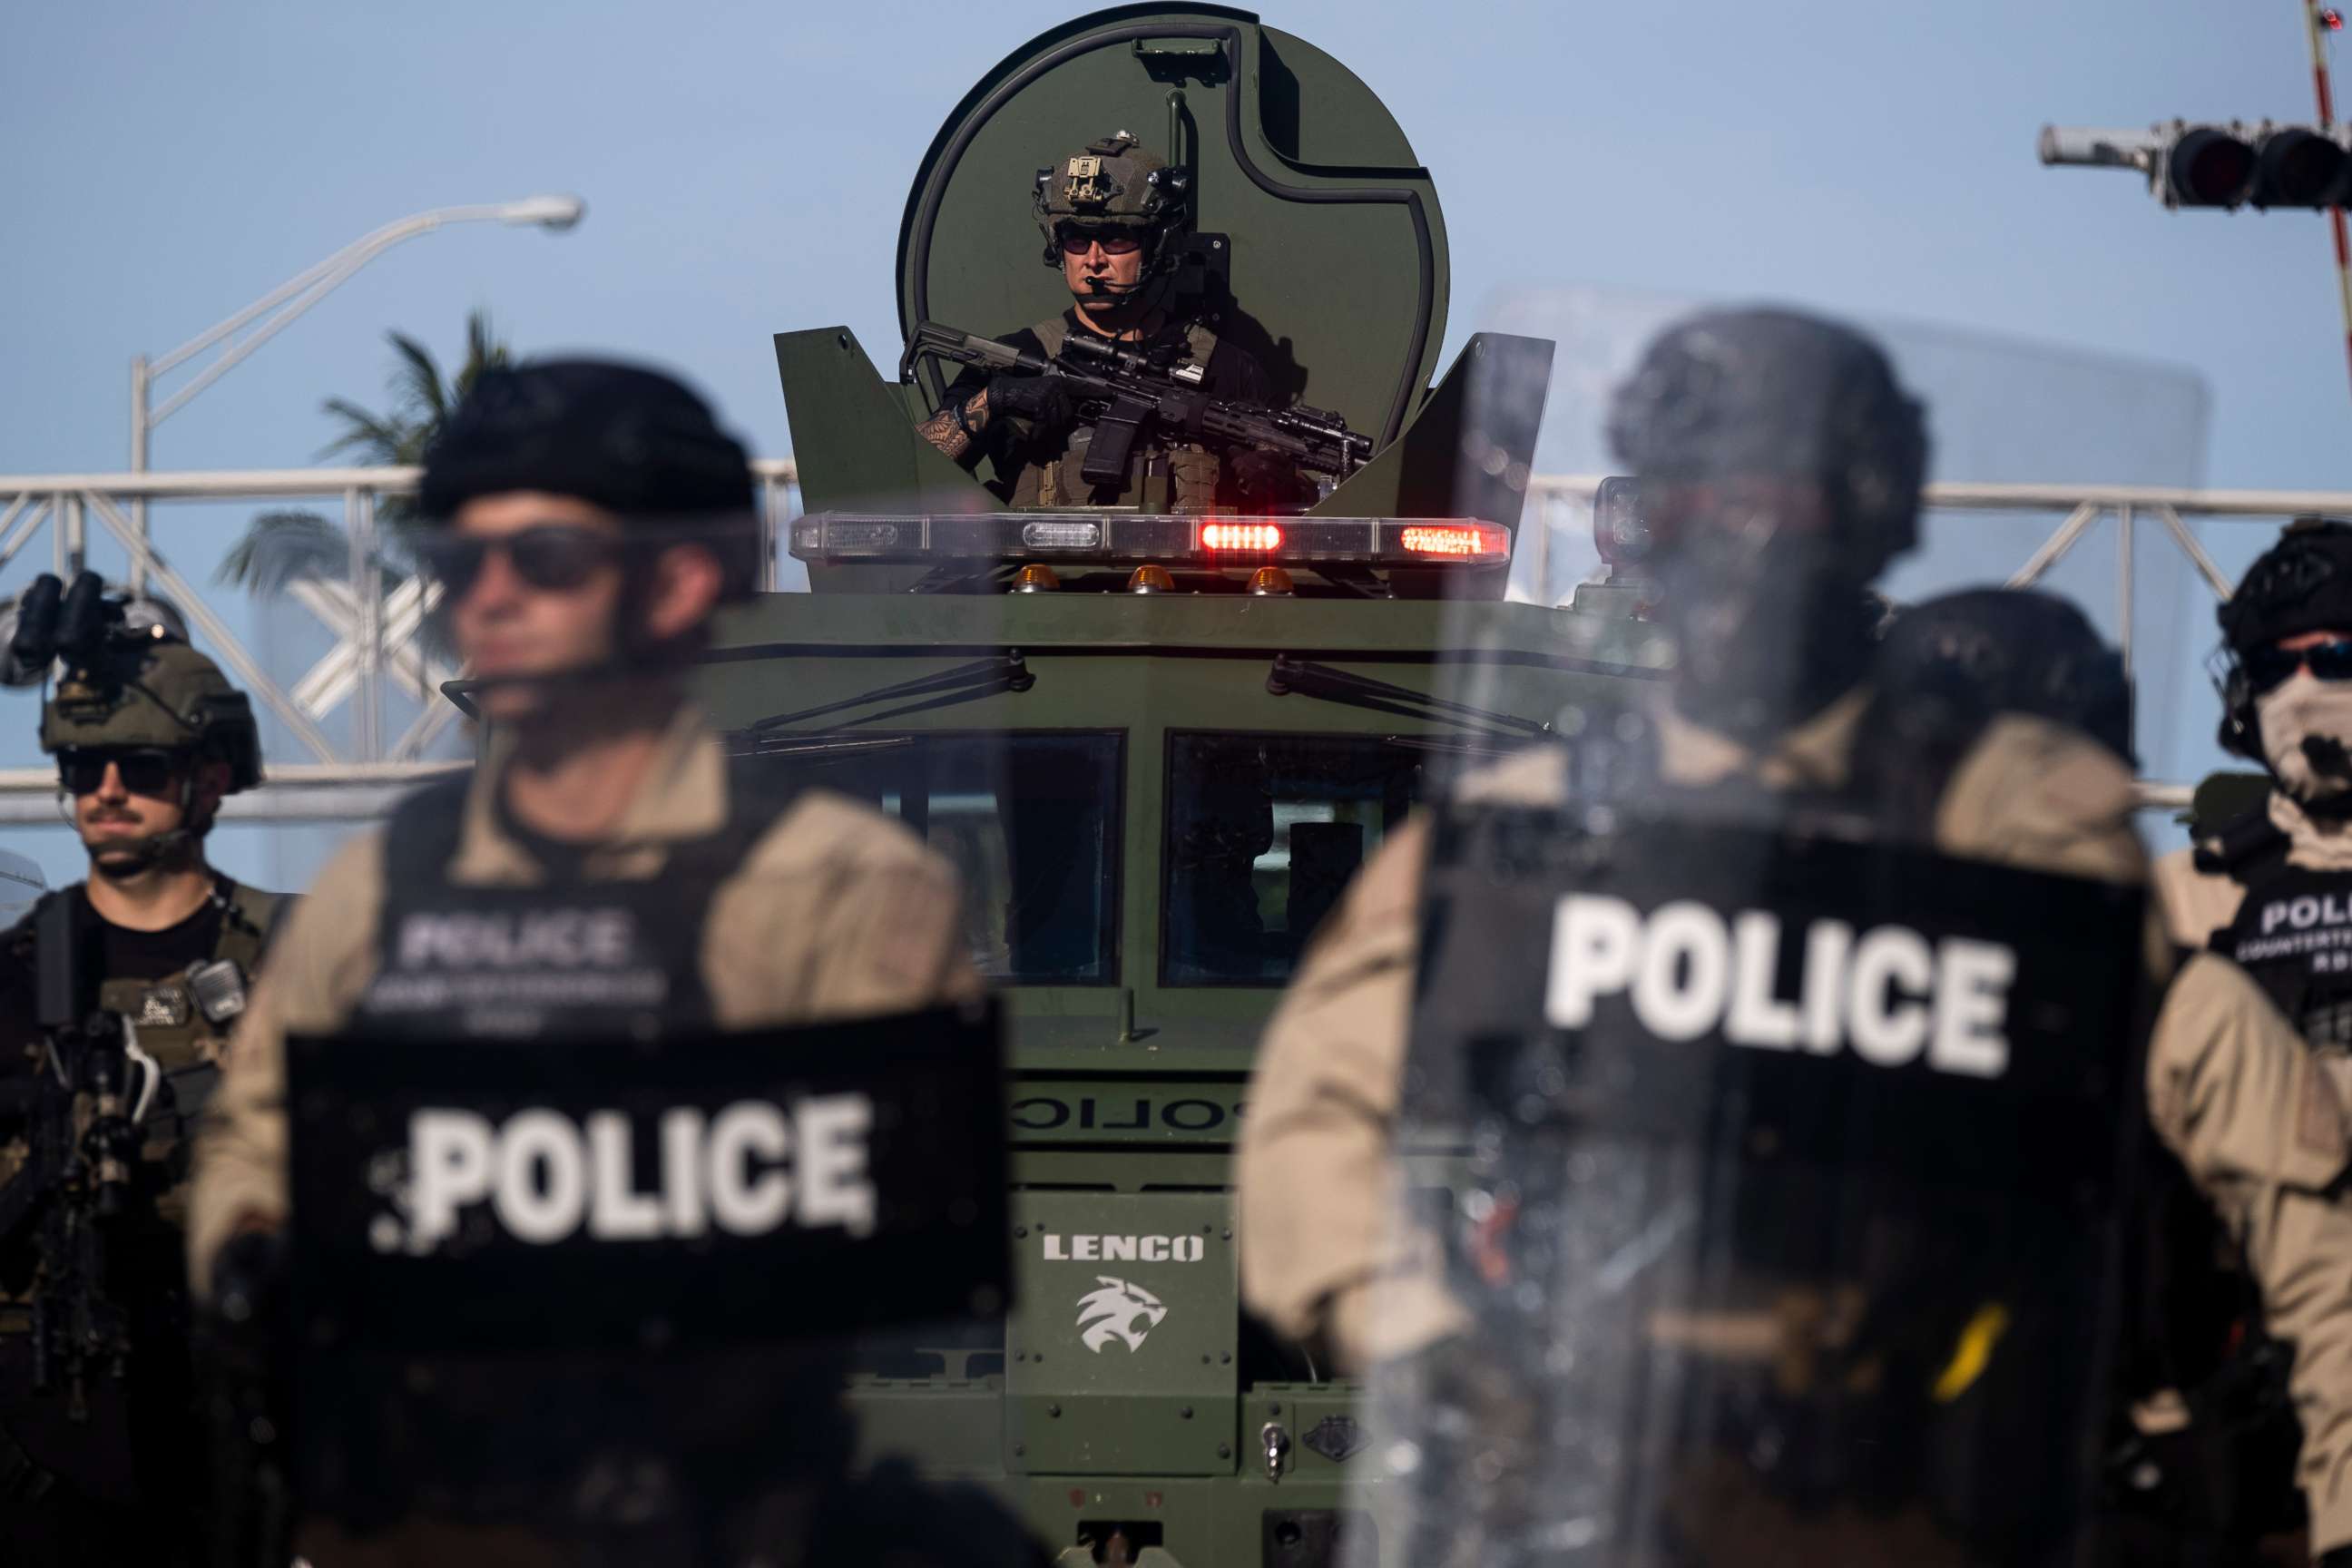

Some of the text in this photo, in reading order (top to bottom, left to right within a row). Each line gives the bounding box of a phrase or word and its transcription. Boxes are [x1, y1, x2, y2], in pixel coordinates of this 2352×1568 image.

[1544, 891, 2014, 1076] POLICE
[408, 1093, 874, 1250] POLICE
[1043, 1234, 1204, 1262] LENCO
